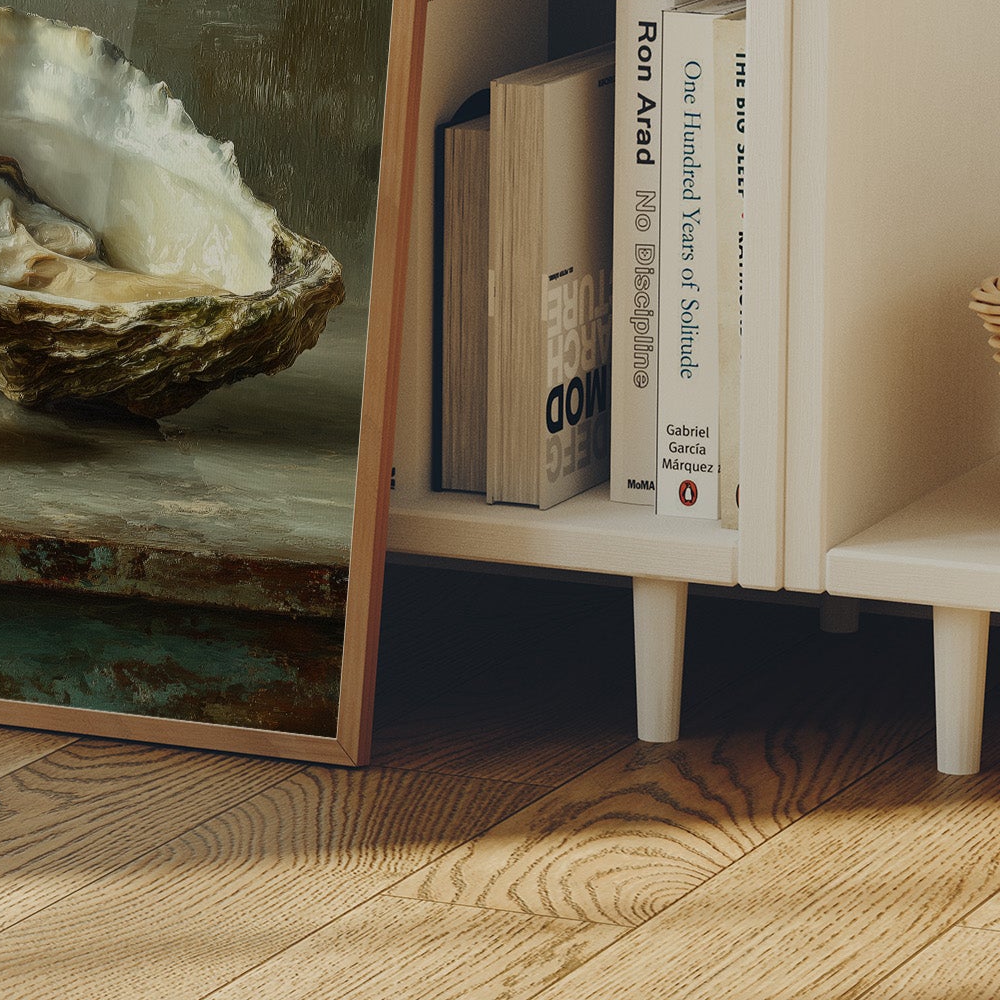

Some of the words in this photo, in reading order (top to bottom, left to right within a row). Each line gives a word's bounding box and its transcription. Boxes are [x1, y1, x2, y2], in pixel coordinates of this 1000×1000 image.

[637, 21, 657, 81] Ron
[684, 60, 702, 104] One
[636, 92, 656, 165] Arad
[682, 112, 701, 201] Hundred
[635, 190, 656, 232] No
[681, 207, 701, 261] Years
[681, 268, 700, 292] of
[630, 244, 655, 389] Discipline
[680, 299, 699, 379] Solitude
[546, 365, 607, 434] MOD
[666, 424, 710, 438] Gabriel
[668, 441, 706, 455] García
[627, 479, 655, 490] MoMA
[661, 458, 713, 474] Márquez
